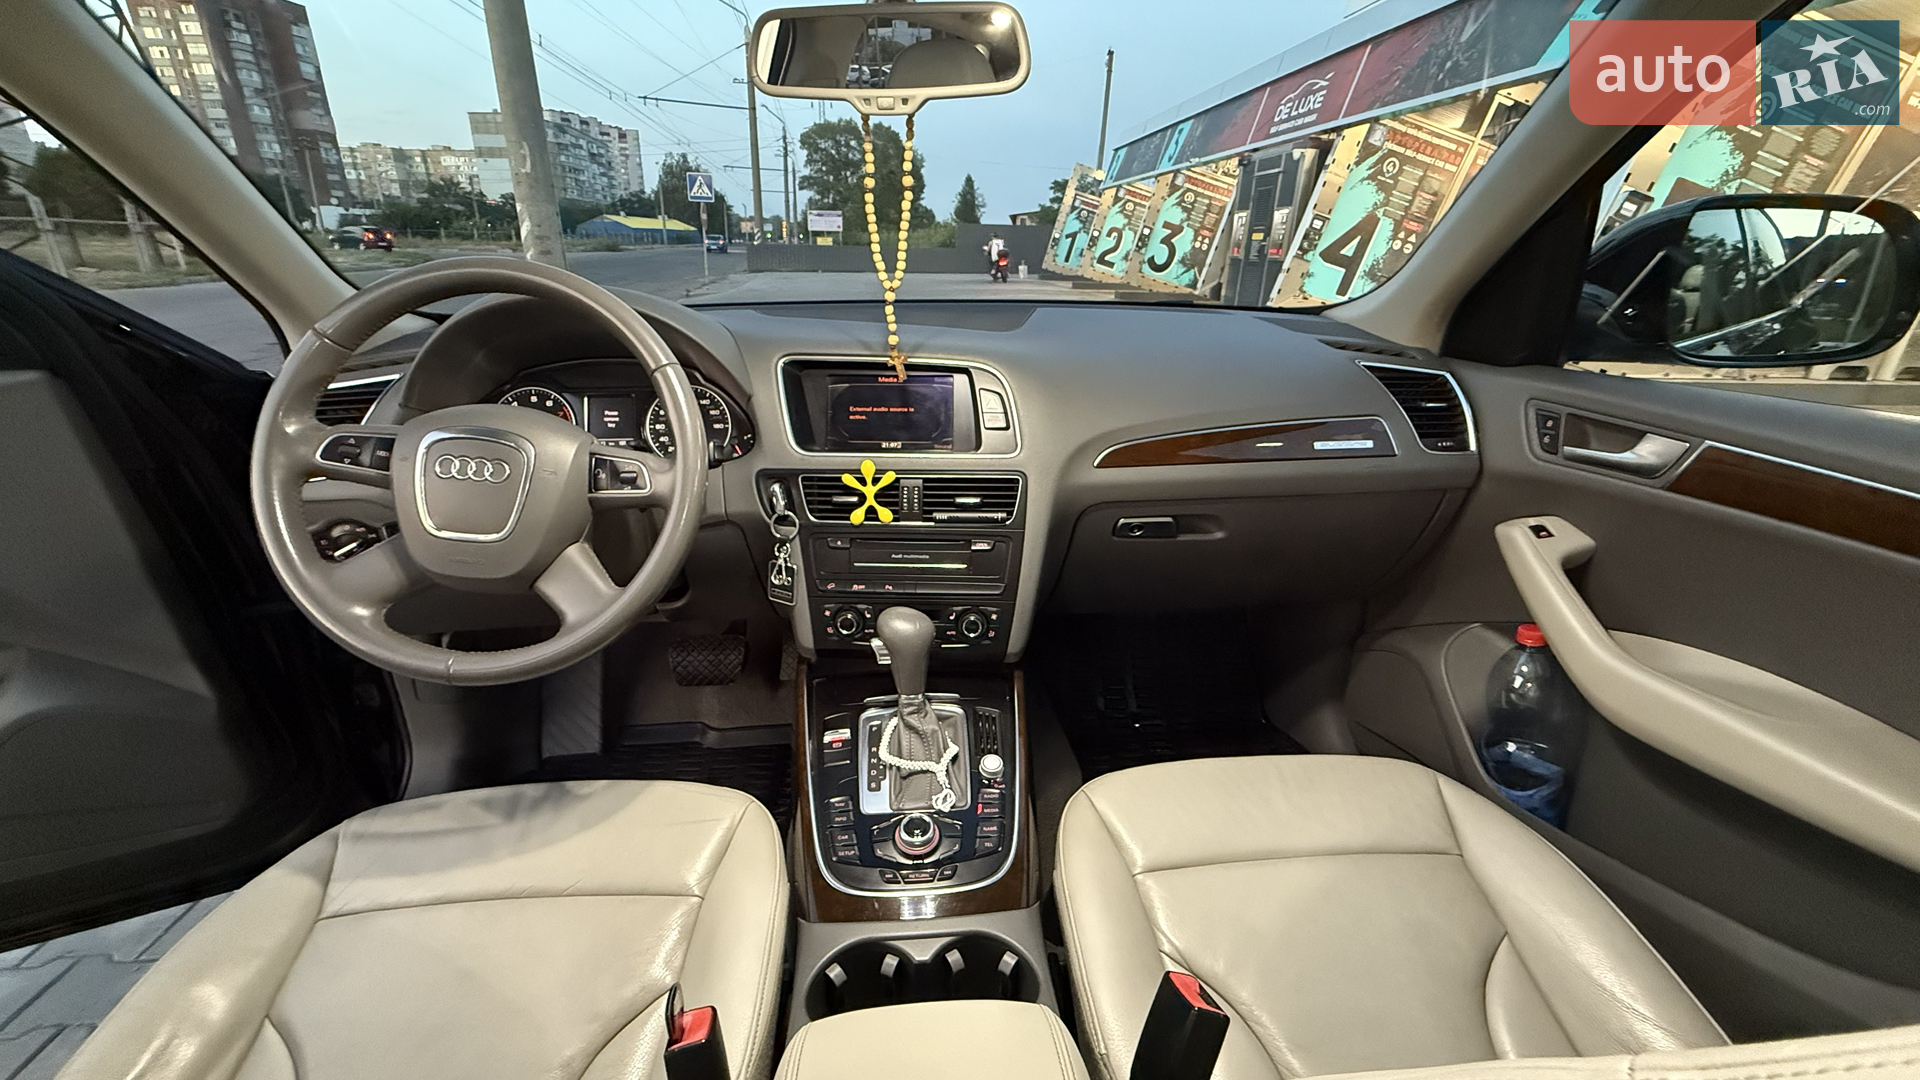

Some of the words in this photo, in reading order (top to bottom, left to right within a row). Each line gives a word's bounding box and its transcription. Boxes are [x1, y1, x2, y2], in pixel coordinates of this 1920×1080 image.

[1274, 102, 1293, 122] DE
[1290, 90, 1327, 116] LUXE
[1065, 232, 1078, 263] 1
[1096, 227, 1124, 270] 2
[1147, 220, 1186, 275] 3
[1320, 213, 1383, 298] 4
